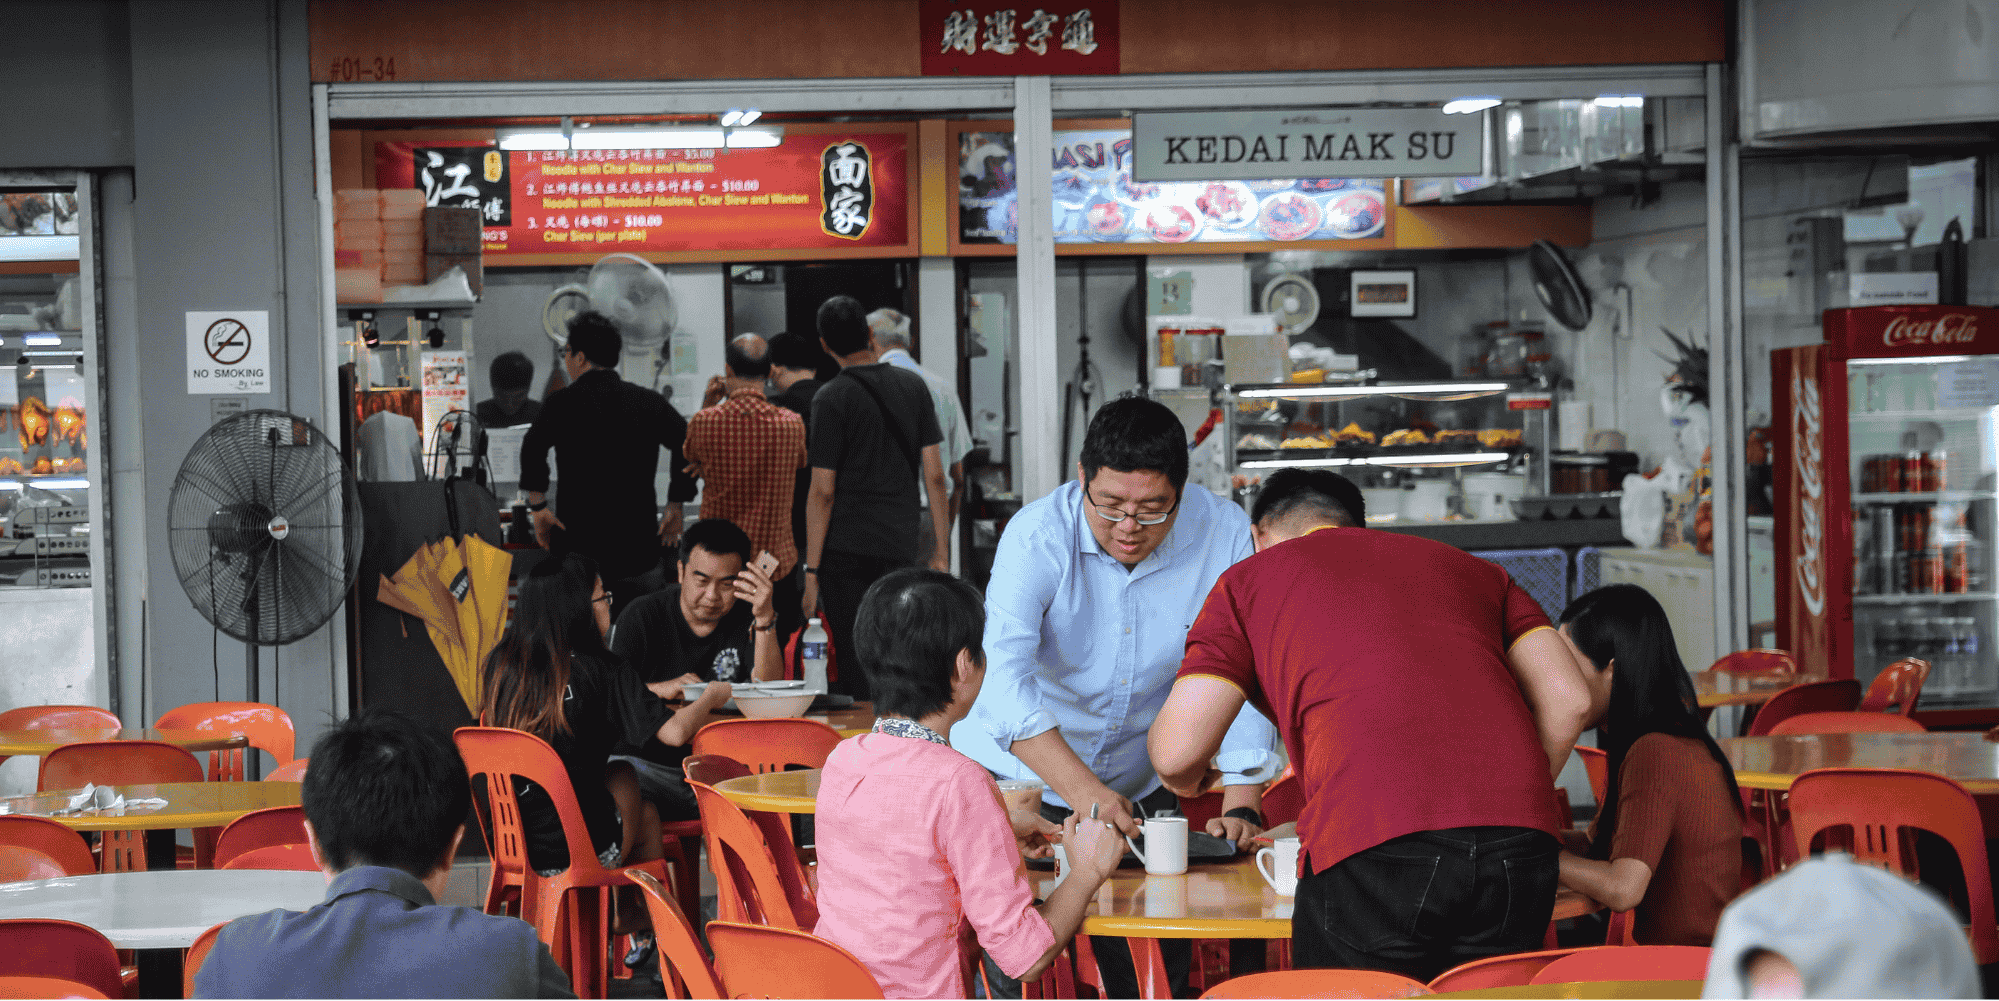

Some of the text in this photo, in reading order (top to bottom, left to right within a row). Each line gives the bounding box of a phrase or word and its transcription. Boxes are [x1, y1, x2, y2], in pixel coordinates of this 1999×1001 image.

[940, 8, 1098, 56] 財運亨通
[331, 57, 396, 81] #01-34
[1052, 142, 1105, 170] ASI
[1163, 131, 1457, 165] KEDAI MAK SU
[541, 163, 579, 175] Noodle
[579, 163, 602, 175] with
[602, 162, 628, 175] Char
[628, 161, 654, 174] Siew
[654, 162, 675, 174] and
[721, 179, 760, 193] $10.00
[829, 144, 868, 235] 面家
[542, 196, 579, 209] Noodle
[579, 196, 603, 208] with
[603, 195, 652, 208] Shredded
[652, 194, 697, 208] Abalone,
[698, 193, 722, 206] Char
[723, 192, 749, 206] Siew
[749, 193, 770, 205] and
[527, 216, 539, 229] 3.
[624, 213, 663, 228] $10.00
[543, 228, 647, 244] Char Siew (per plate)
[193, 368, 264, 378] NO SMOKING
[238, 380, 248, 388] By
